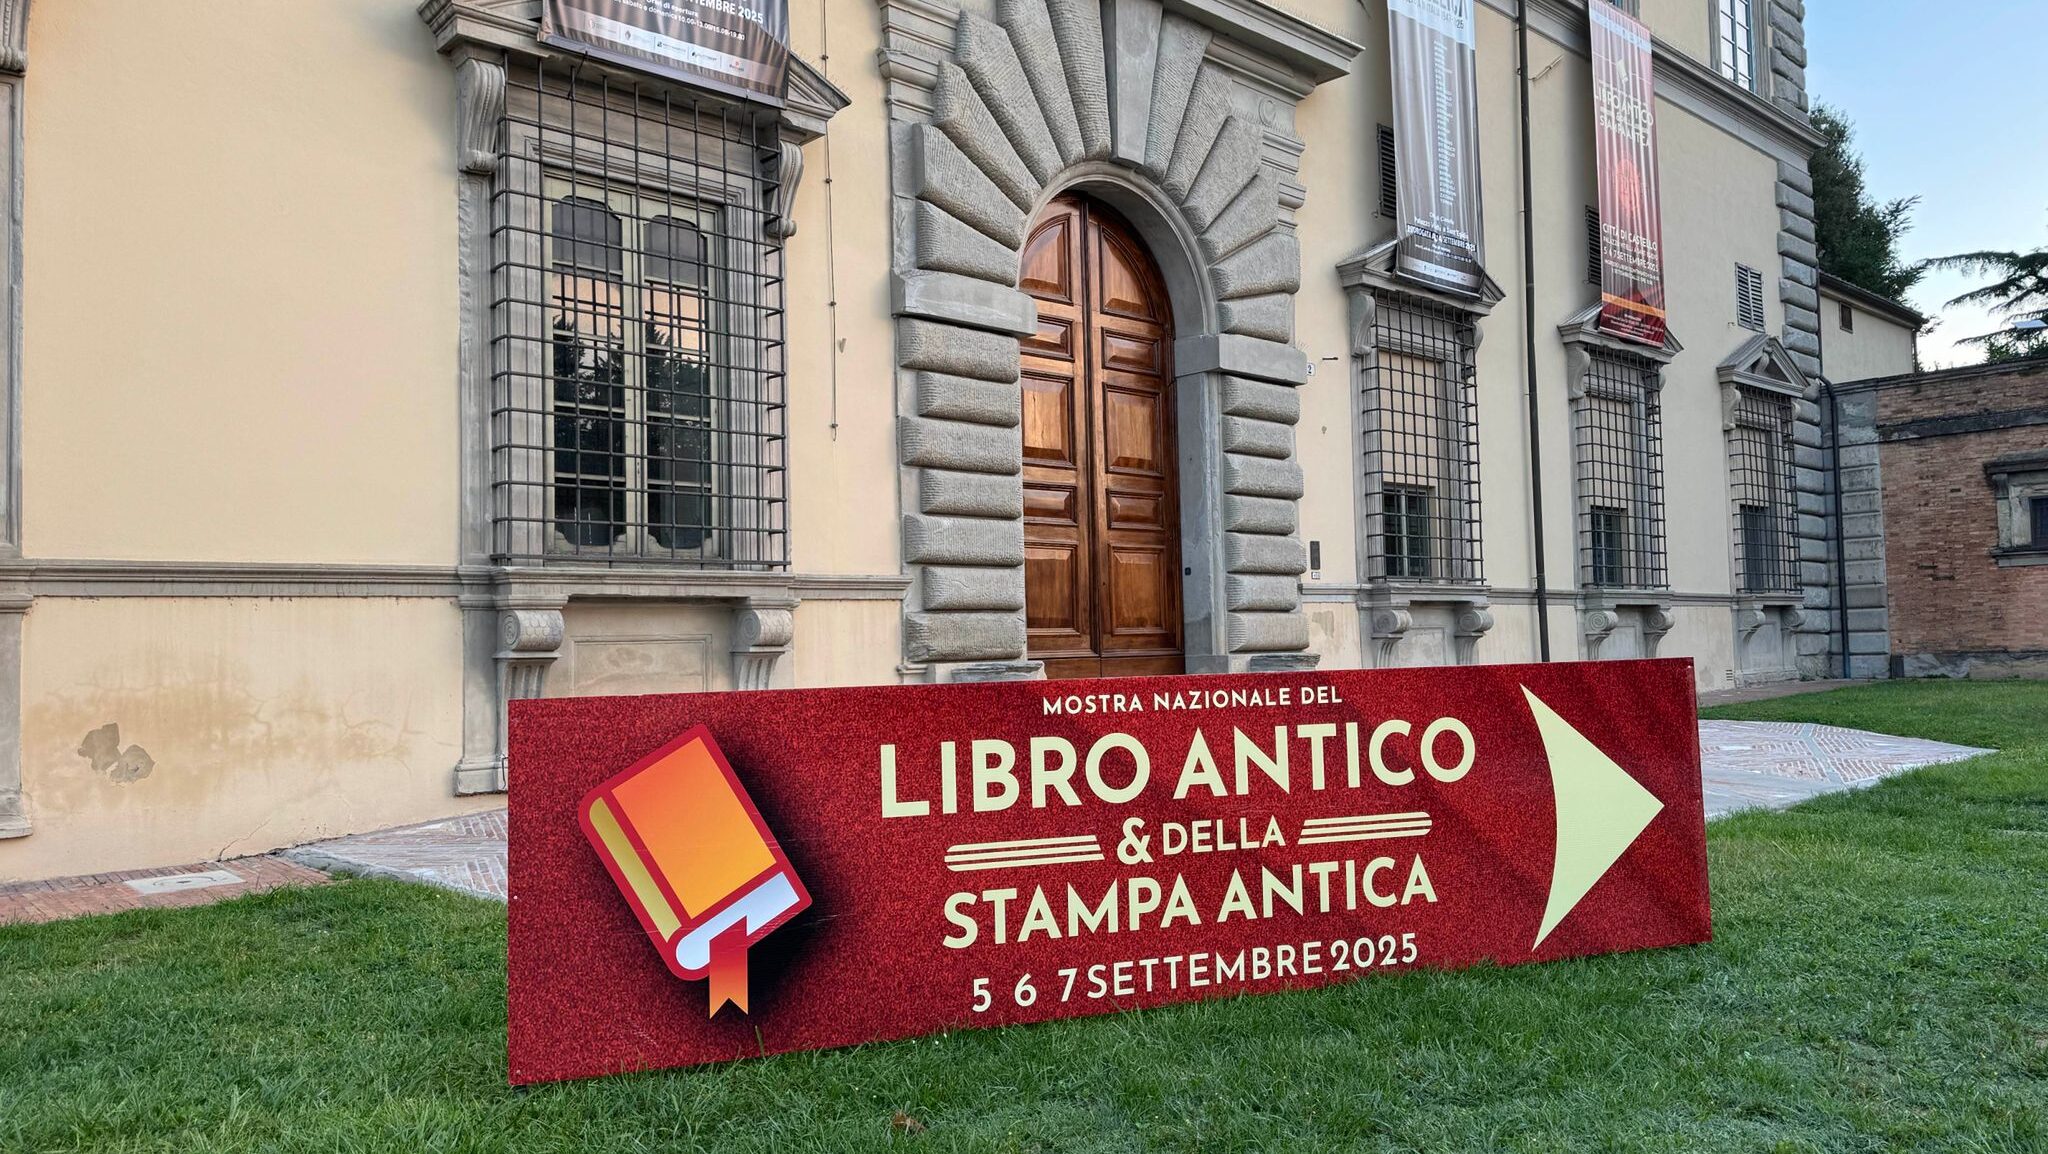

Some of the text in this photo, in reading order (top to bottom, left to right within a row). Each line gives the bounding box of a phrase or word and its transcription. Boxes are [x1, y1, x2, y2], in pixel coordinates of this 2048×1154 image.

[685, 0, 763, 24] EMBRE 2025
[1628, 232, 1657, 251] CASTELLO
[1043, 685, 1343, 716] MOSTRA NAZIONALE DEL
[880, 716, 1476, 819] LIBRO ANTICO
[1116, 814, 1287, 865] & DELLA
[942, 852, 1438, 949] STAMPA ANTICA
[972, 932, 1418, 1013] 5 6 7 SETTEMBRE 2025
